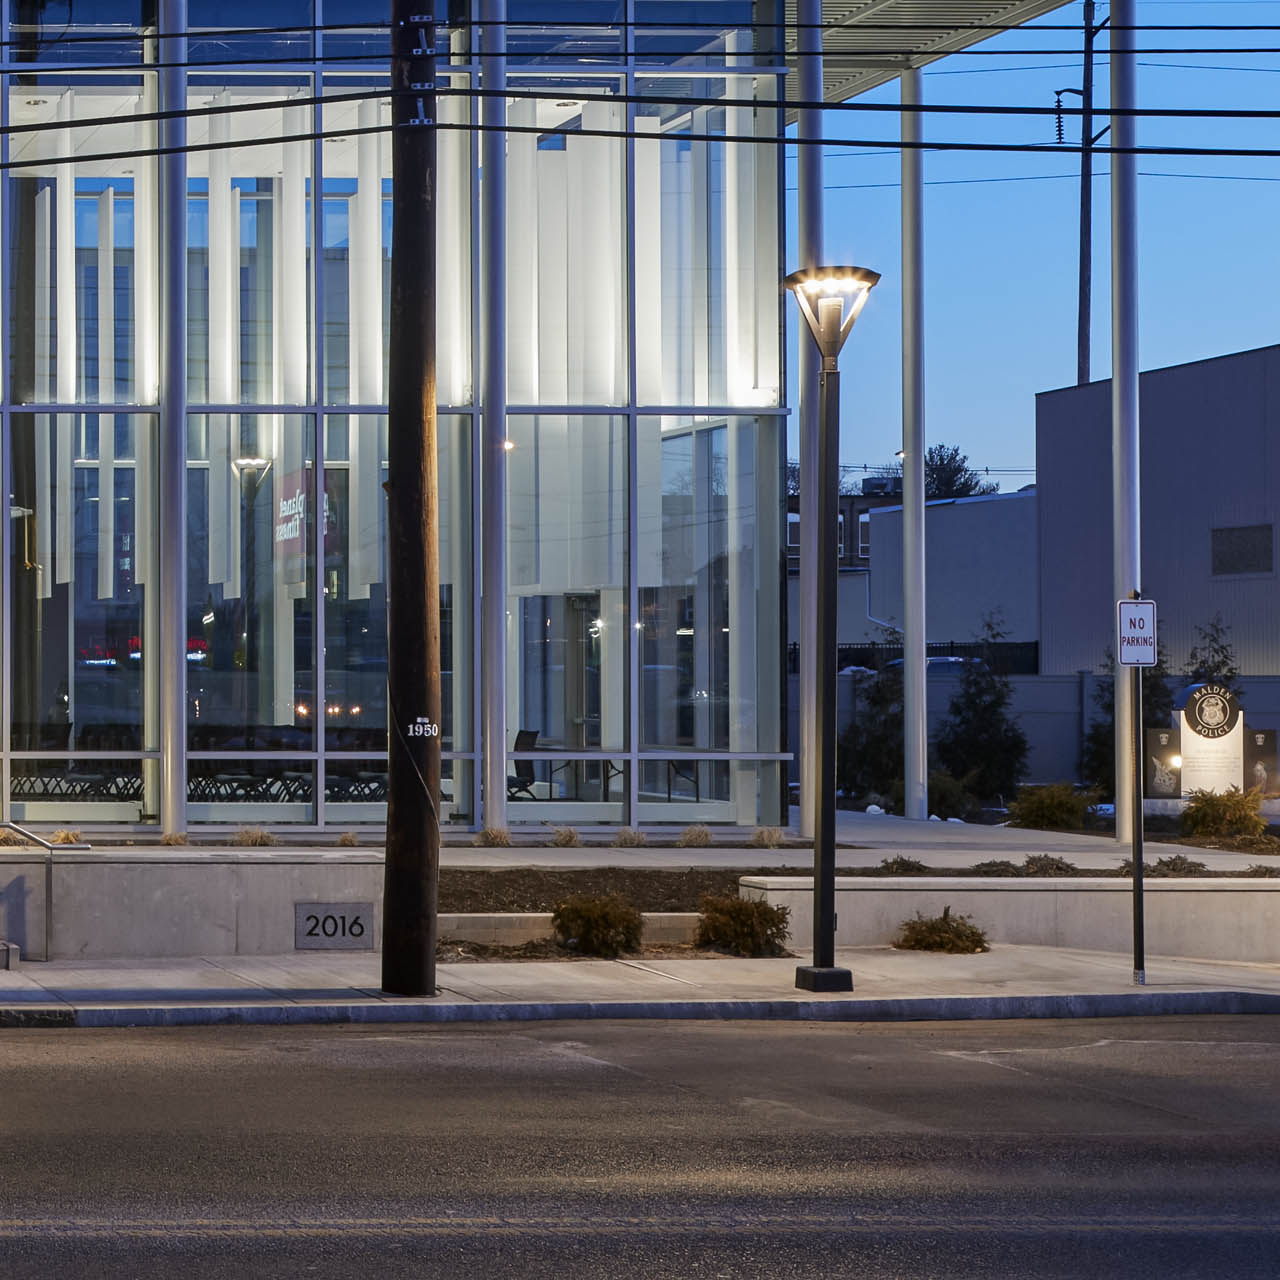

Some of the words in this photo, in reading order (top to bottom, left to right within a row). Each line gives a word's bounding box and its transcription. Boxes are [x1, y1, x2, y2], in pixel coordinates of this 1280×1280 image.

[1129, 617, 1145, 630] NO
[1122, 636, 1153, 647] PARKING
[1193, 686, 1232, 701] MALDEN
[407, 723, 439, 737] 1950
[1195, 724, 1231, 737] POLICE
[305, 914, 365, 938] 2016
